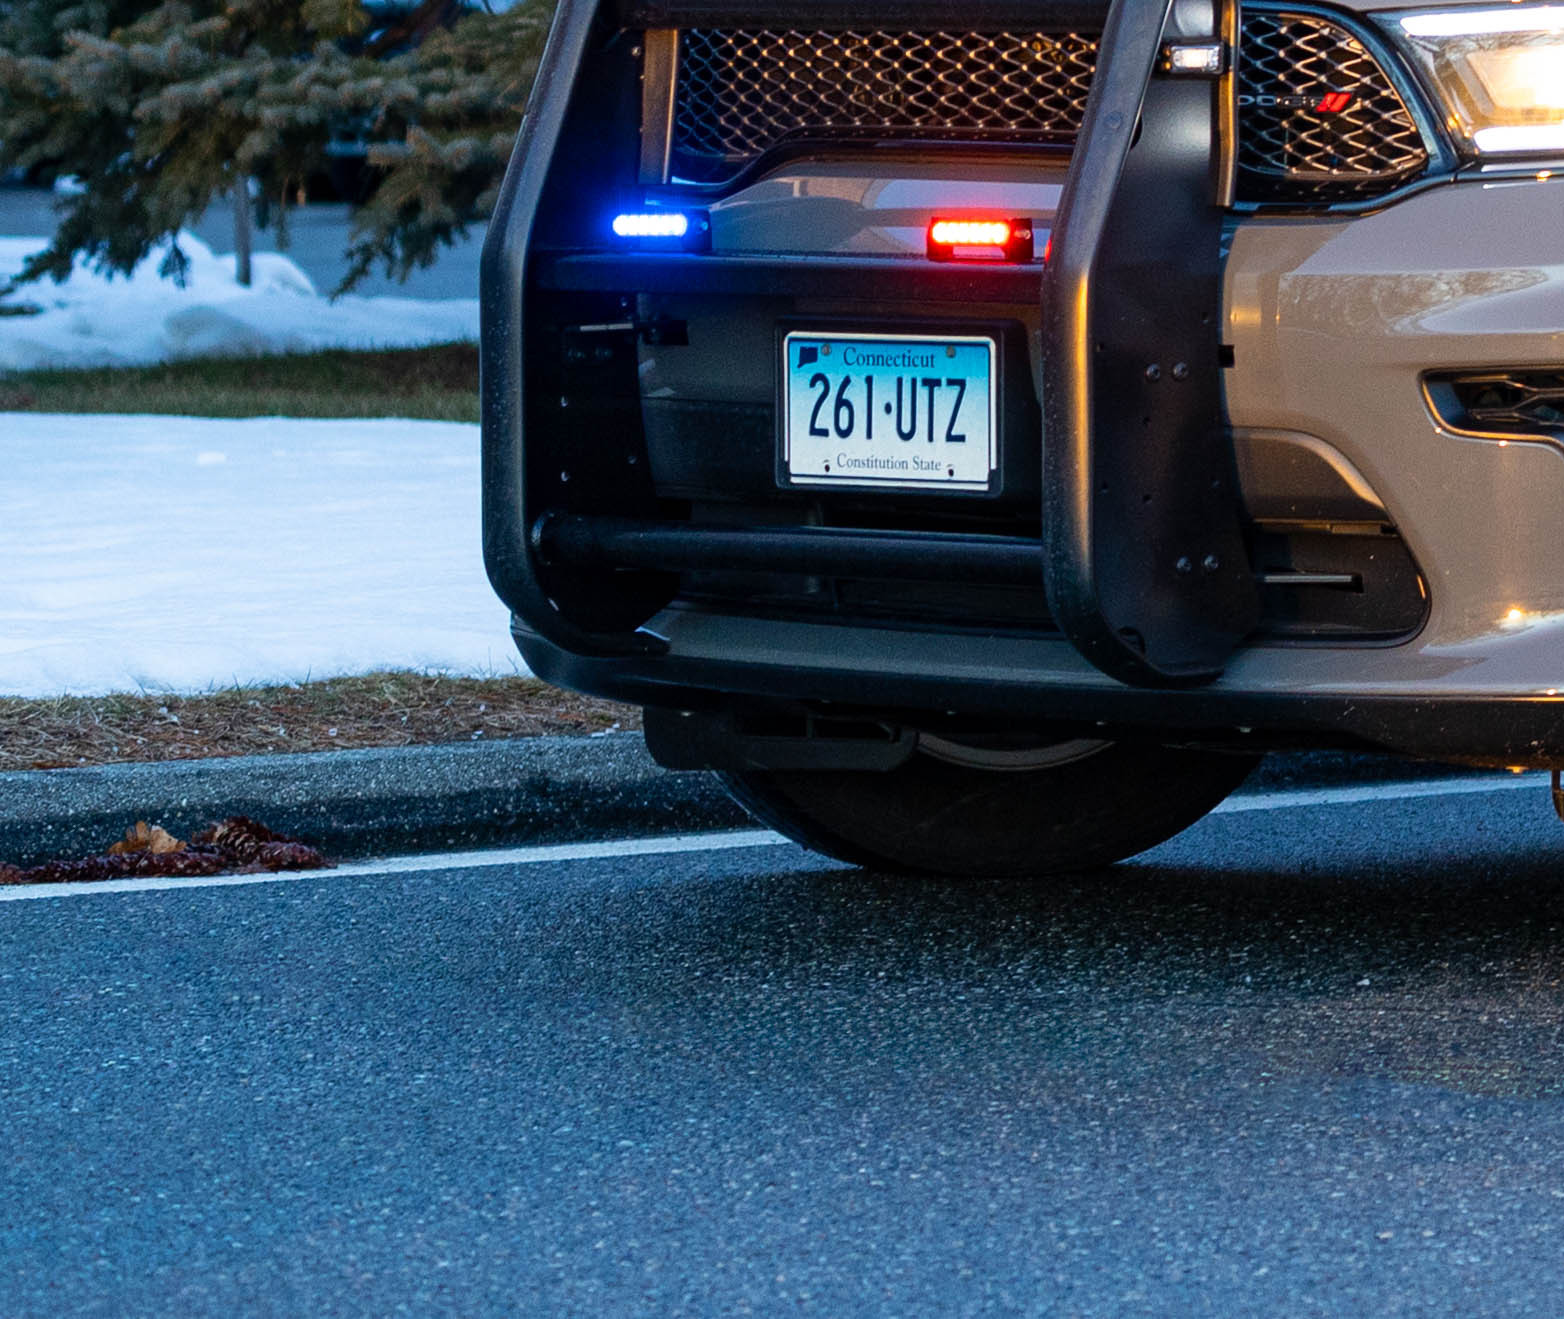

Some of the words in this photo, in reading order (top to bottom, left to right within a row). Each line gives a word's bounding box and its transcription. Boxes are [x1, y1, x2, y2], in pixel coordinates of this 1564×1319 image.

[843, 347, 936, 368] Connecticut
[836, 453, 909, 470] Constitution
[912, 456, 942, 471] State
